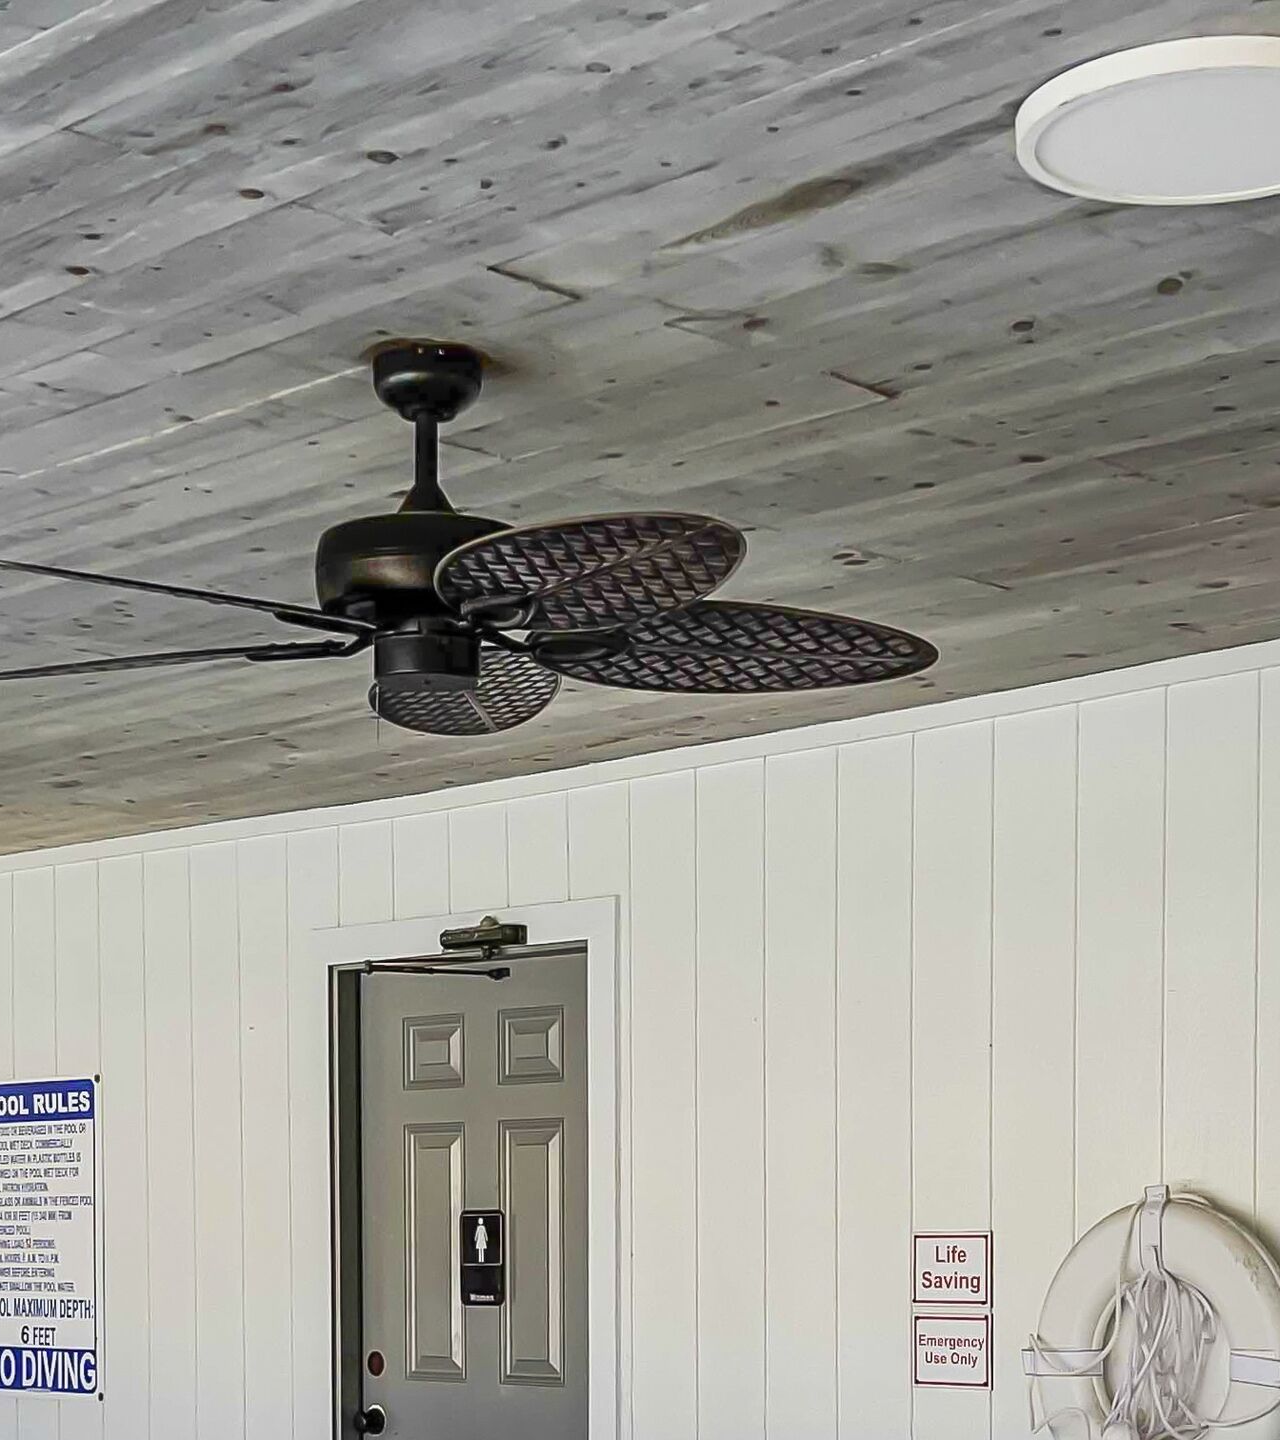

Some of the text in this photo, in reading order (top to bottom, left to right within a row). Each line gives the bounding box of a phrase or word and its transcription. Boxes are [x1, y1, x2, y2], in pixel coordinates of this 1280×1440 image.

[33, 1091, 90, 1114] RULES
[64, 1123, 78, 1134] POOL
[936, 1245, 967, 1263] Life
[922, 1271, 980, 1294] Saving
[14, 1298, 57, 1318] MAXIMUM
[60, 1299, 94, 1319] DEPTH:
[21, 1325, 56, 1346] 6 FEET
[918, 1334, 985, 1351] Emergency
[22, 1349, 96, 1391] DIVING
[925, 1351, 978, 1368] Use Only
